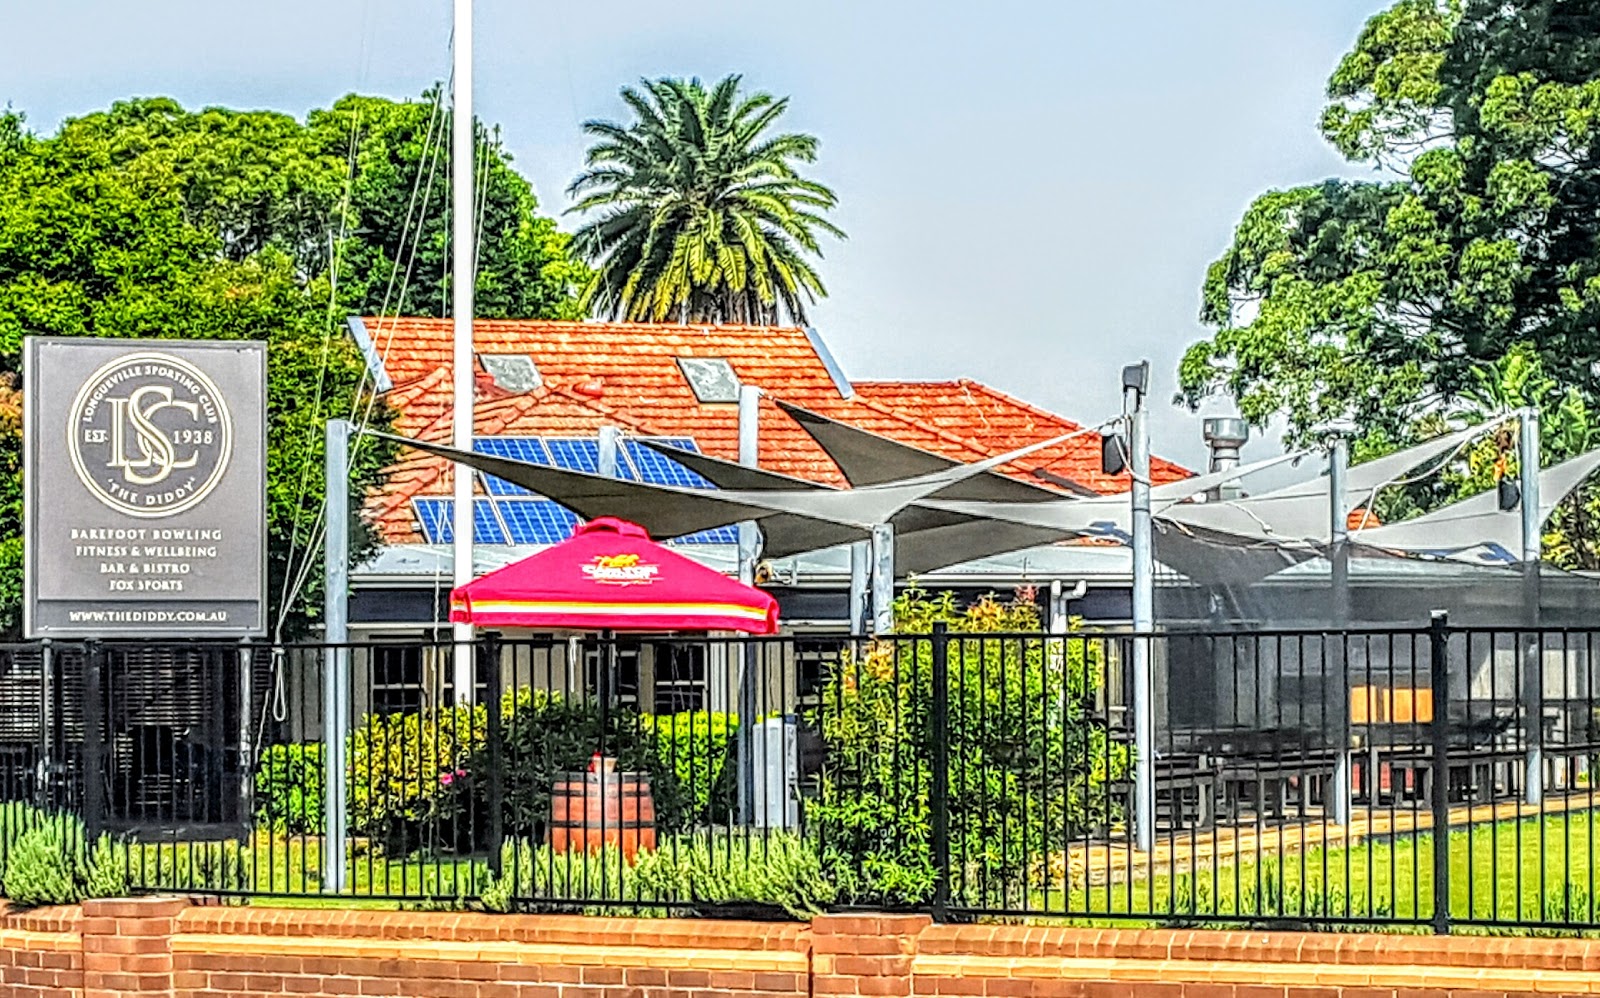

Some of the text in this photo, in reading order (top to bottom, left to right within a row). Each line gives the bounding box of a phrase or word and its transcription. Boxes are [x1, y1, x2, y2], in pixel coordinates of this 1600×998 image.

[82, 365, 218, 424] LONGUEVILLE SPORTING CLUB
[84, 429, 108, 443] EST.
[173, 430, 213, 444] 1938
[71, 529, 222, 540] BAREFOOT BOWLING
[76, 546, 217, 558] FITNESS & WELLBEING
[100, 563, 190, 574] BAR & BISTRO
[109, 580, 183, 591] FOX SPORTS
[69, 611, 227, 622] WWW.THEDIDDY.COM.AU
